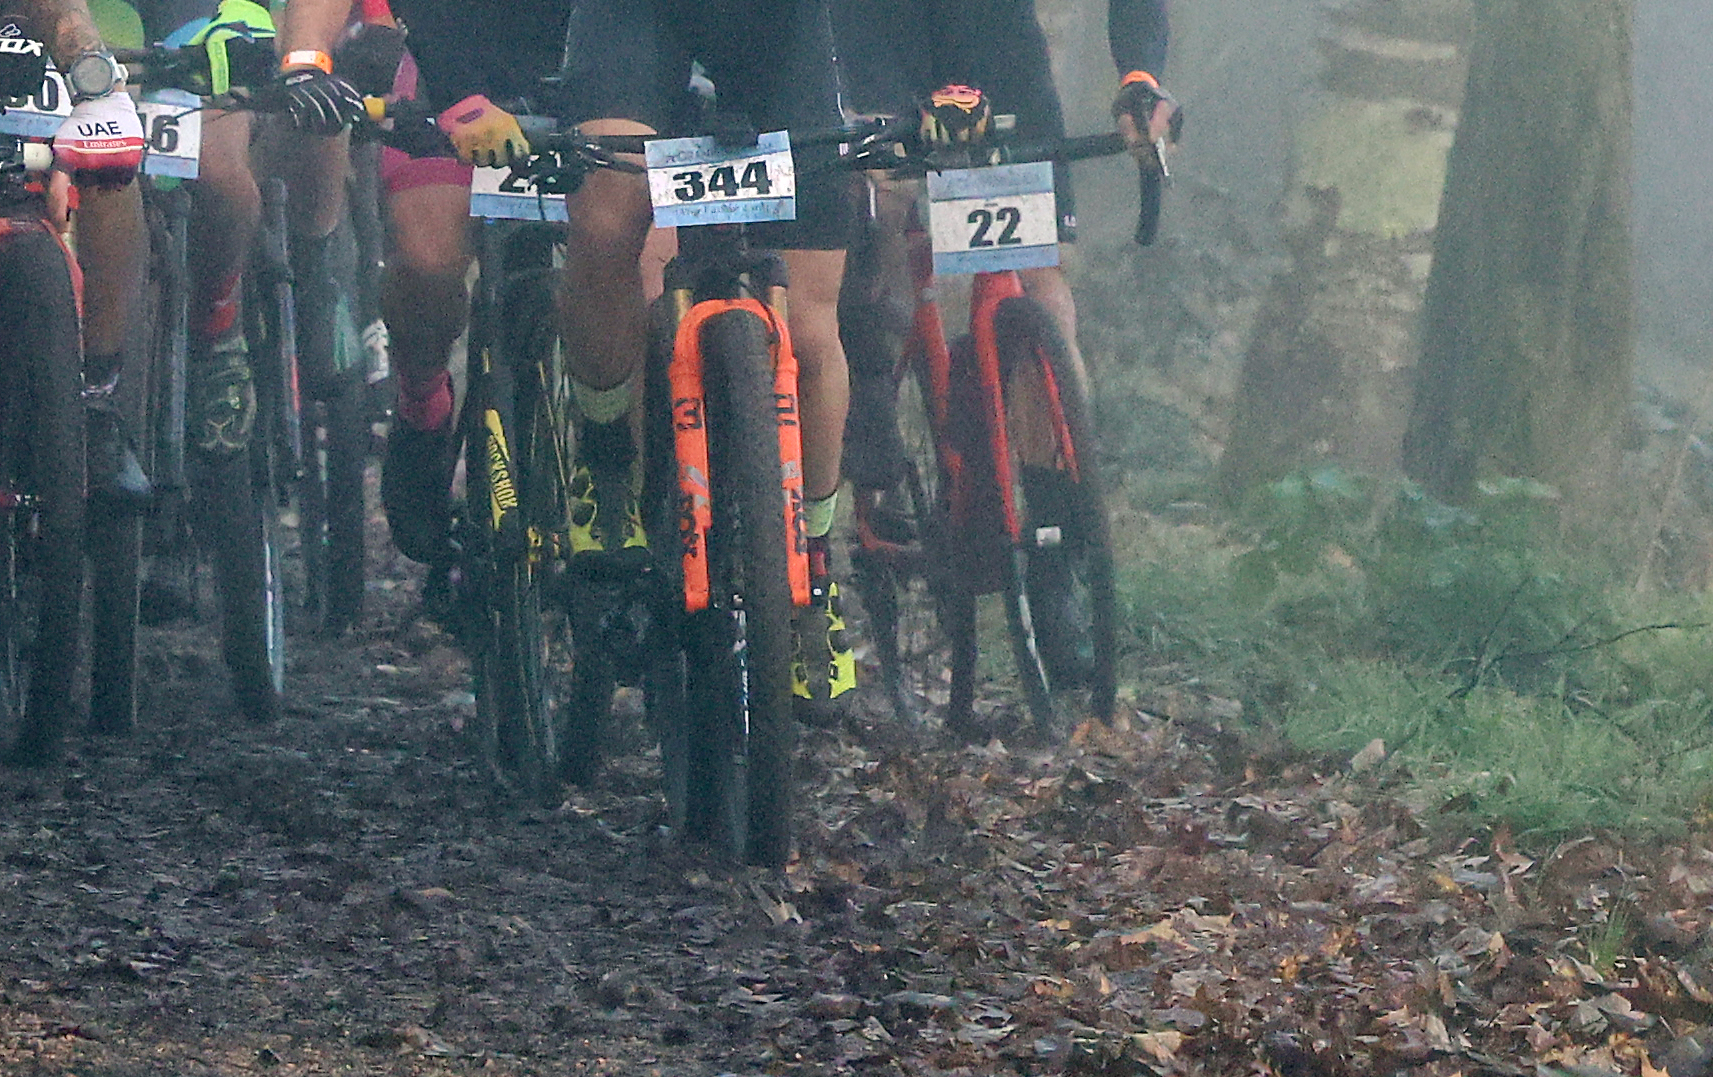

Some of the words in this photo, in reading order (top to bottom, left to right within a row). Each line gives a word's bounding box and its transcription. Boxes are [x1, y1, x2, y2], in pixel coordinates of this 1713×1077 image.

[77, 120, 122, 137] UAE
[83, 139, 128, 149] Emirates
[672, 160, 773, 202] 344
[967, 206, 1022, 249] 22
